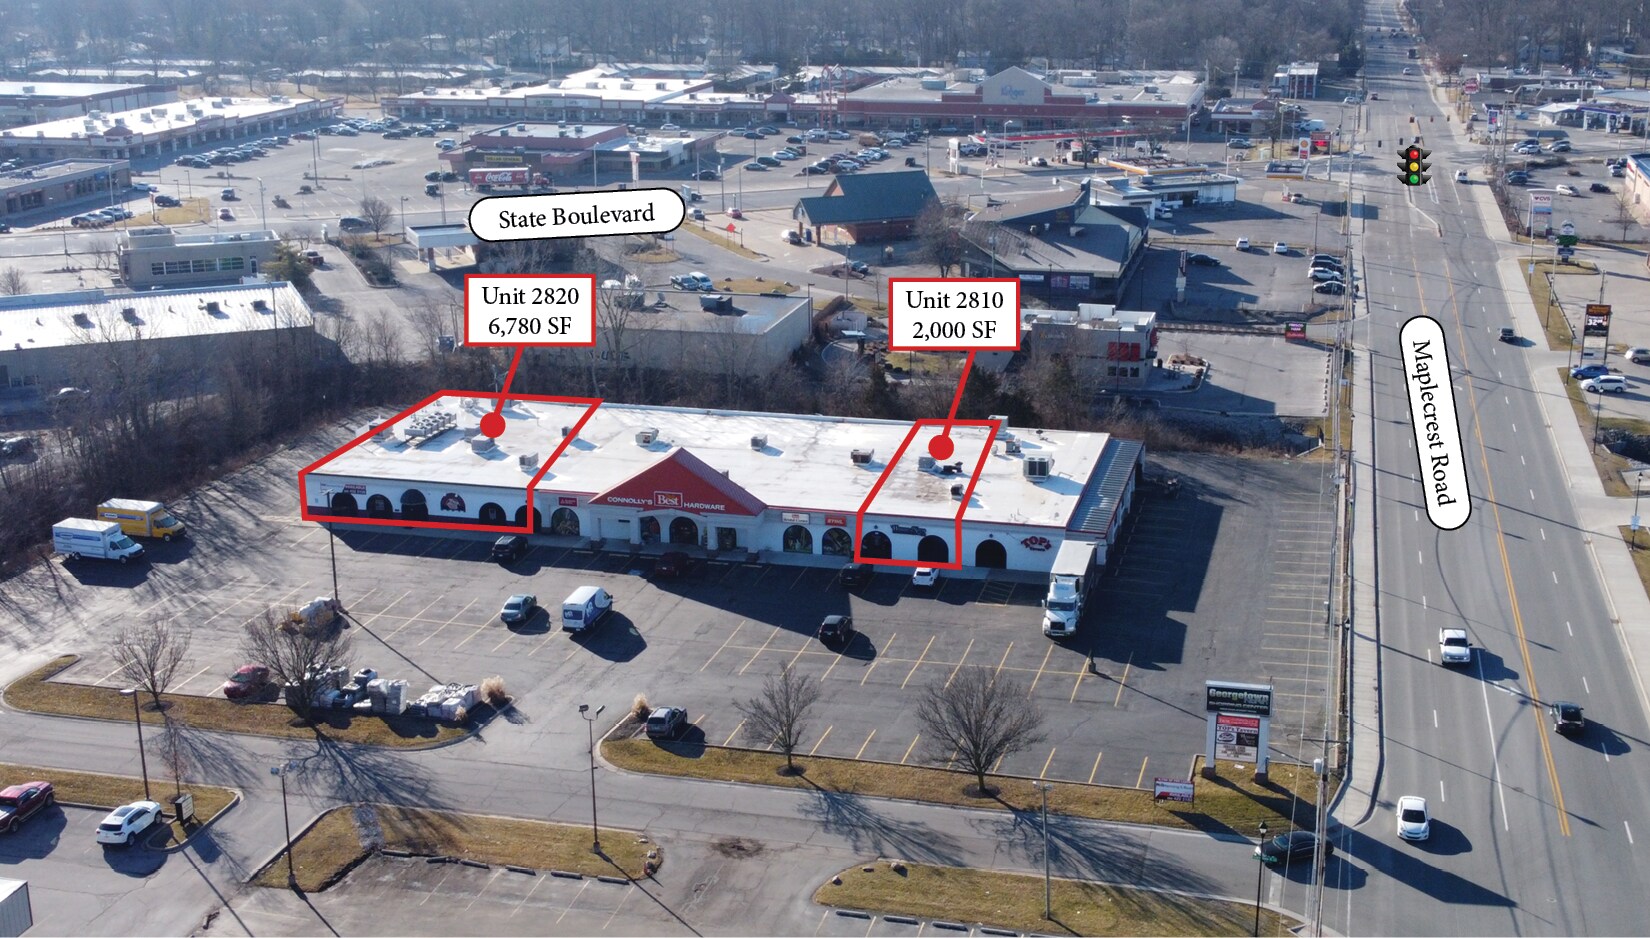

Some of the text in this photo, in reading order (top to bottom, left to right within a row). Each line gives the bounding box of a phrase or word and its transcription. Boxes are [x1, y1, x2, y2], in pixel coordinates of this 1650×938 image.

[607, 494, 726, 511] CONNOLLY'S Best HARDWARE
[1209, 688, 1270, 701] Georgetown
[1236, 727, 1259, 735] Tavern
